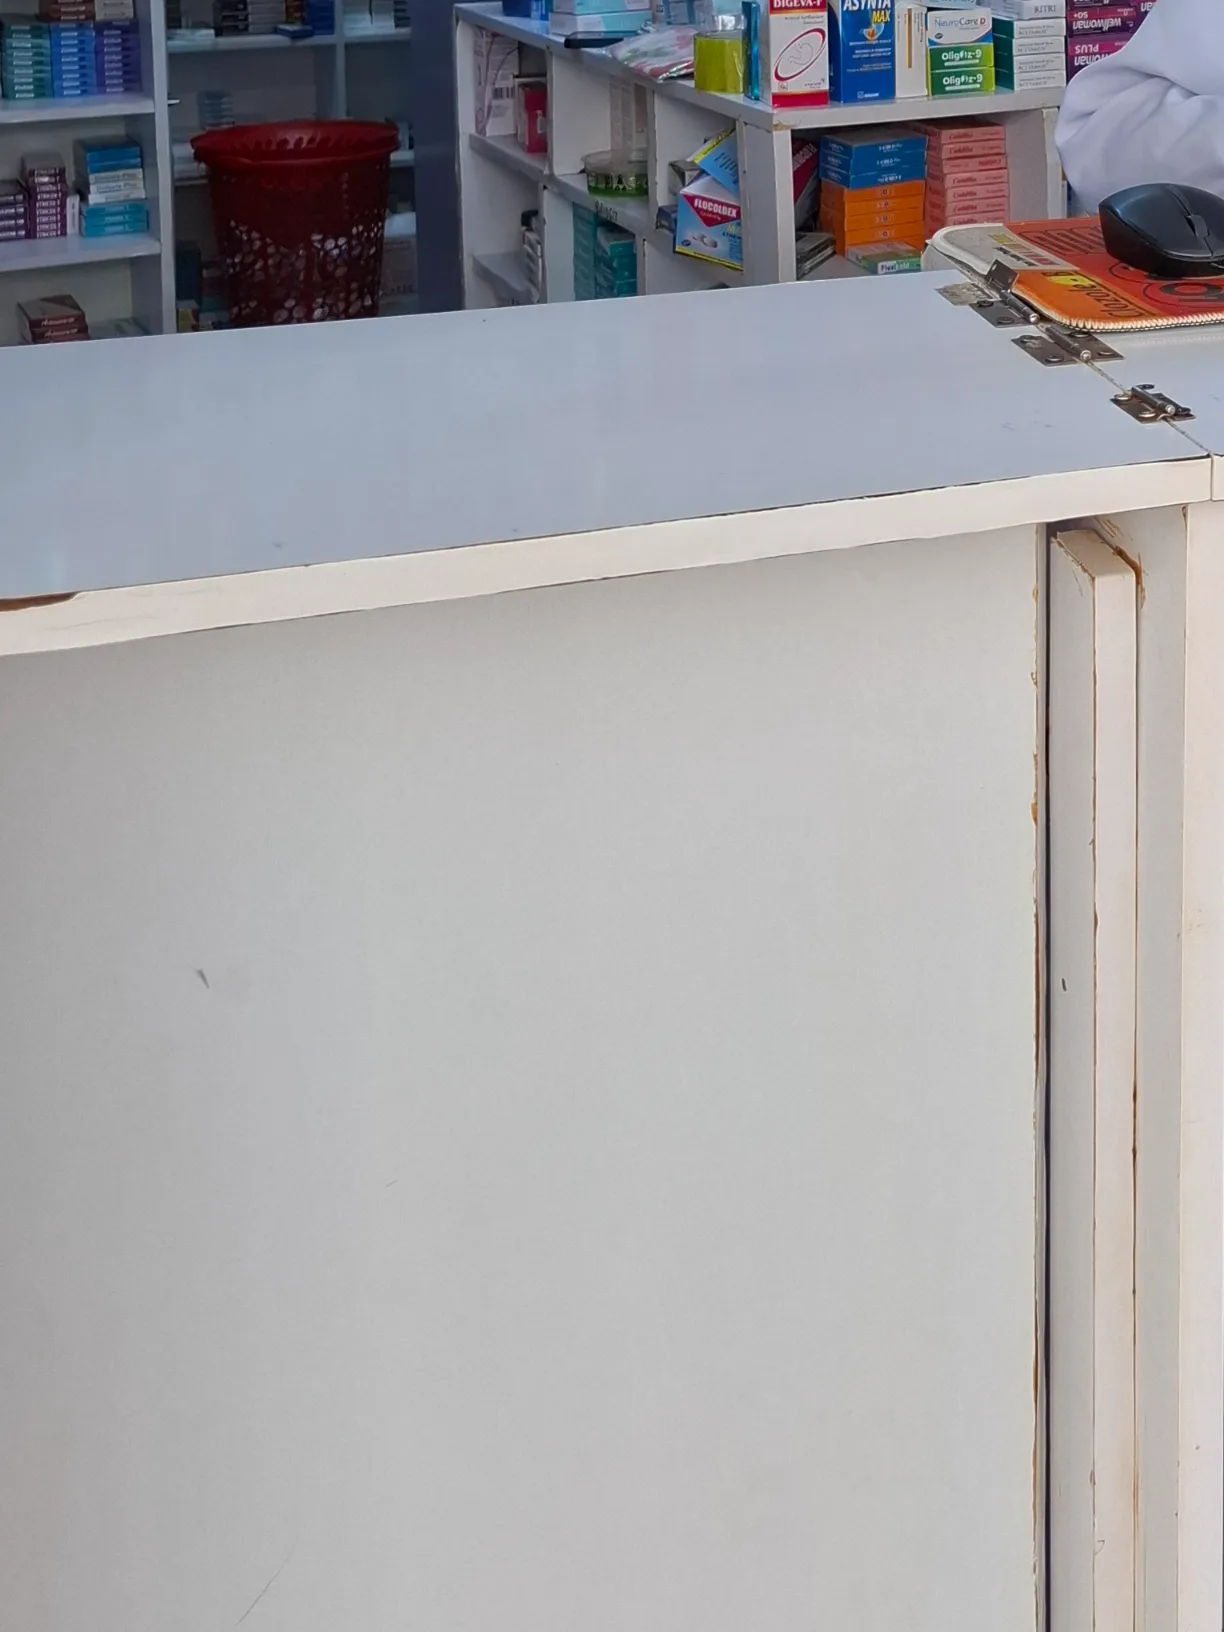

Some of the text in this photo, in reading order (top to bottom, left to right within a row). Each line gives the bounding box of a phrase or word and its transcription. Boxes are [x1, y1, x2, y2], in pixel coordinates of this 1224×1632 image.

[1034, 4, 1057, 14] RITRI
[872, 10, 891, 24] MAX
[935, 17, 978, 29] NeuroCare
[1073, 18, 1121, 31] wellwoman
[1075, 44, 1099, 54] PLUS
[693, 197, 738, 220] FLUCOLDEX
